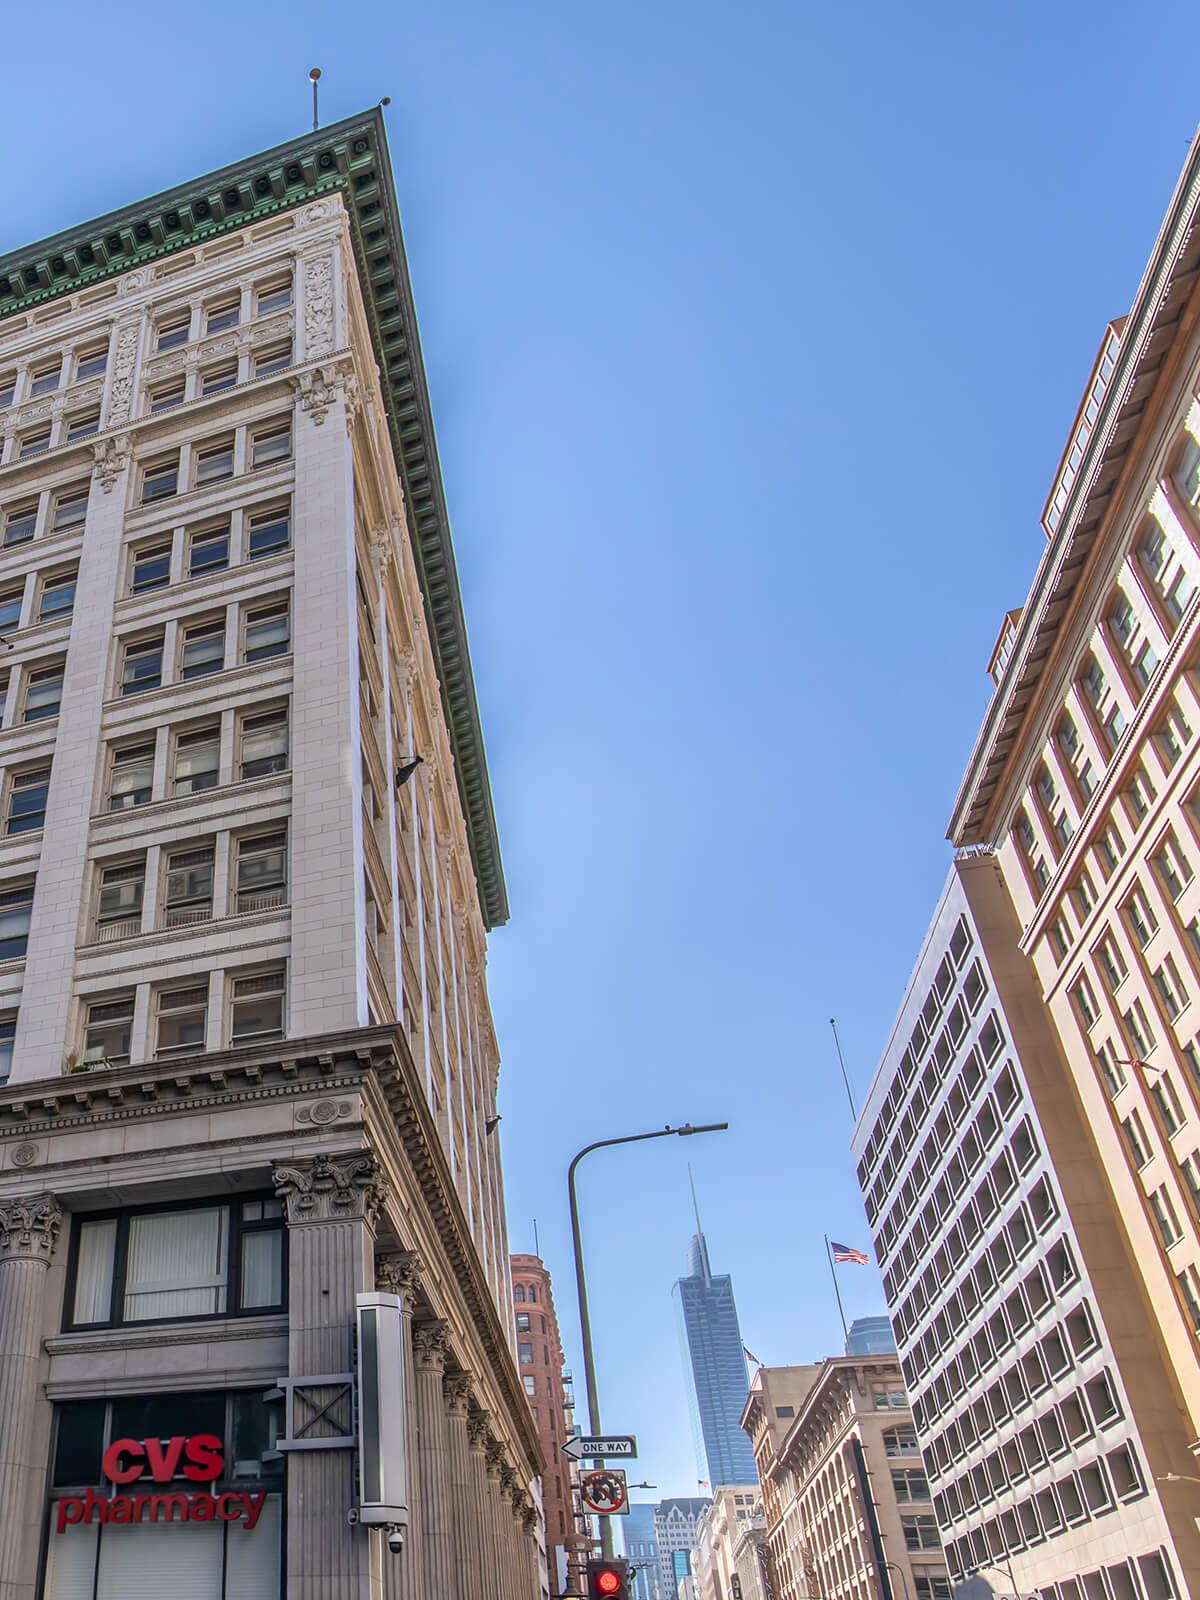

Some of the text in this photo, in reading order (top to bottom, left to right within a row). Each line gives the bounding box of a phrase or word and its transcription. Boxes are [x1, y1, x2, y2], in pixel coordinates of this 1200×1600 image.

[102, 1433, 224, 1484] CVS
[583, 1442, 629, 1452] ONE WAY
[56, 1487, 267, 1534] pharmacy
